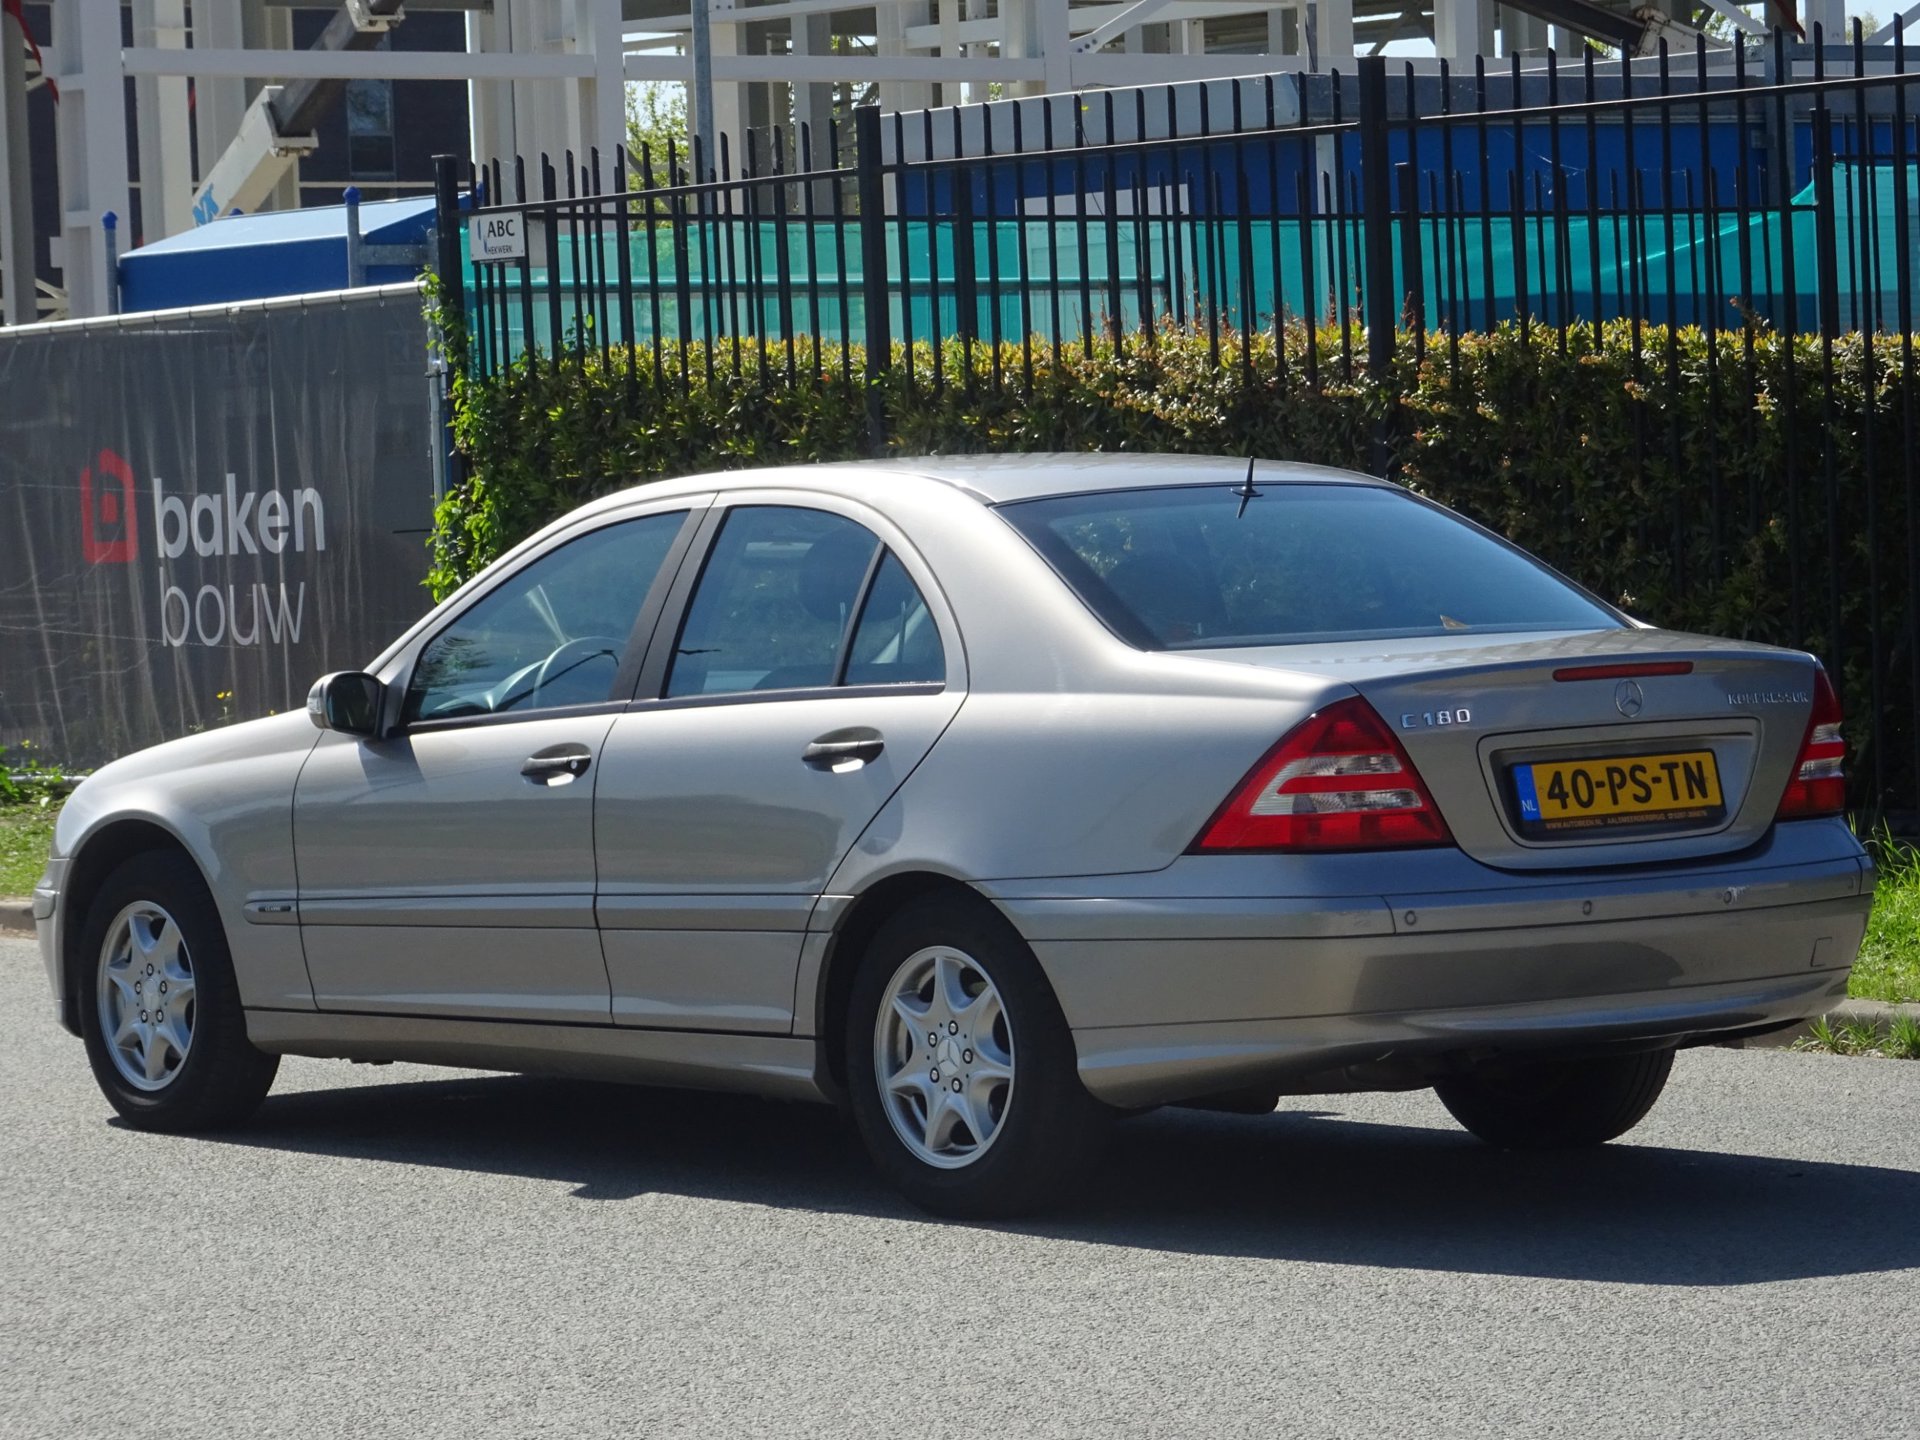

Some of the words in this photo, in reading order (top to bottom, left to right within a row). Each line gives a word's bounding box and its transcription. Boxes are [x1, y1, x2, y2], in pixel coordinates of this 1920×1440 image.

[487, 219, 515, 238] ABC
[153, 473, 326, 559] baken
[159, 566, 305, 647] bouw
[1401, 713, 1417, 729] C
[1423, 708, 1471, 726] 180
[1547, 760, 1709, 810] 40-PS-TN
[1521, 799, 1537, 812] NL
